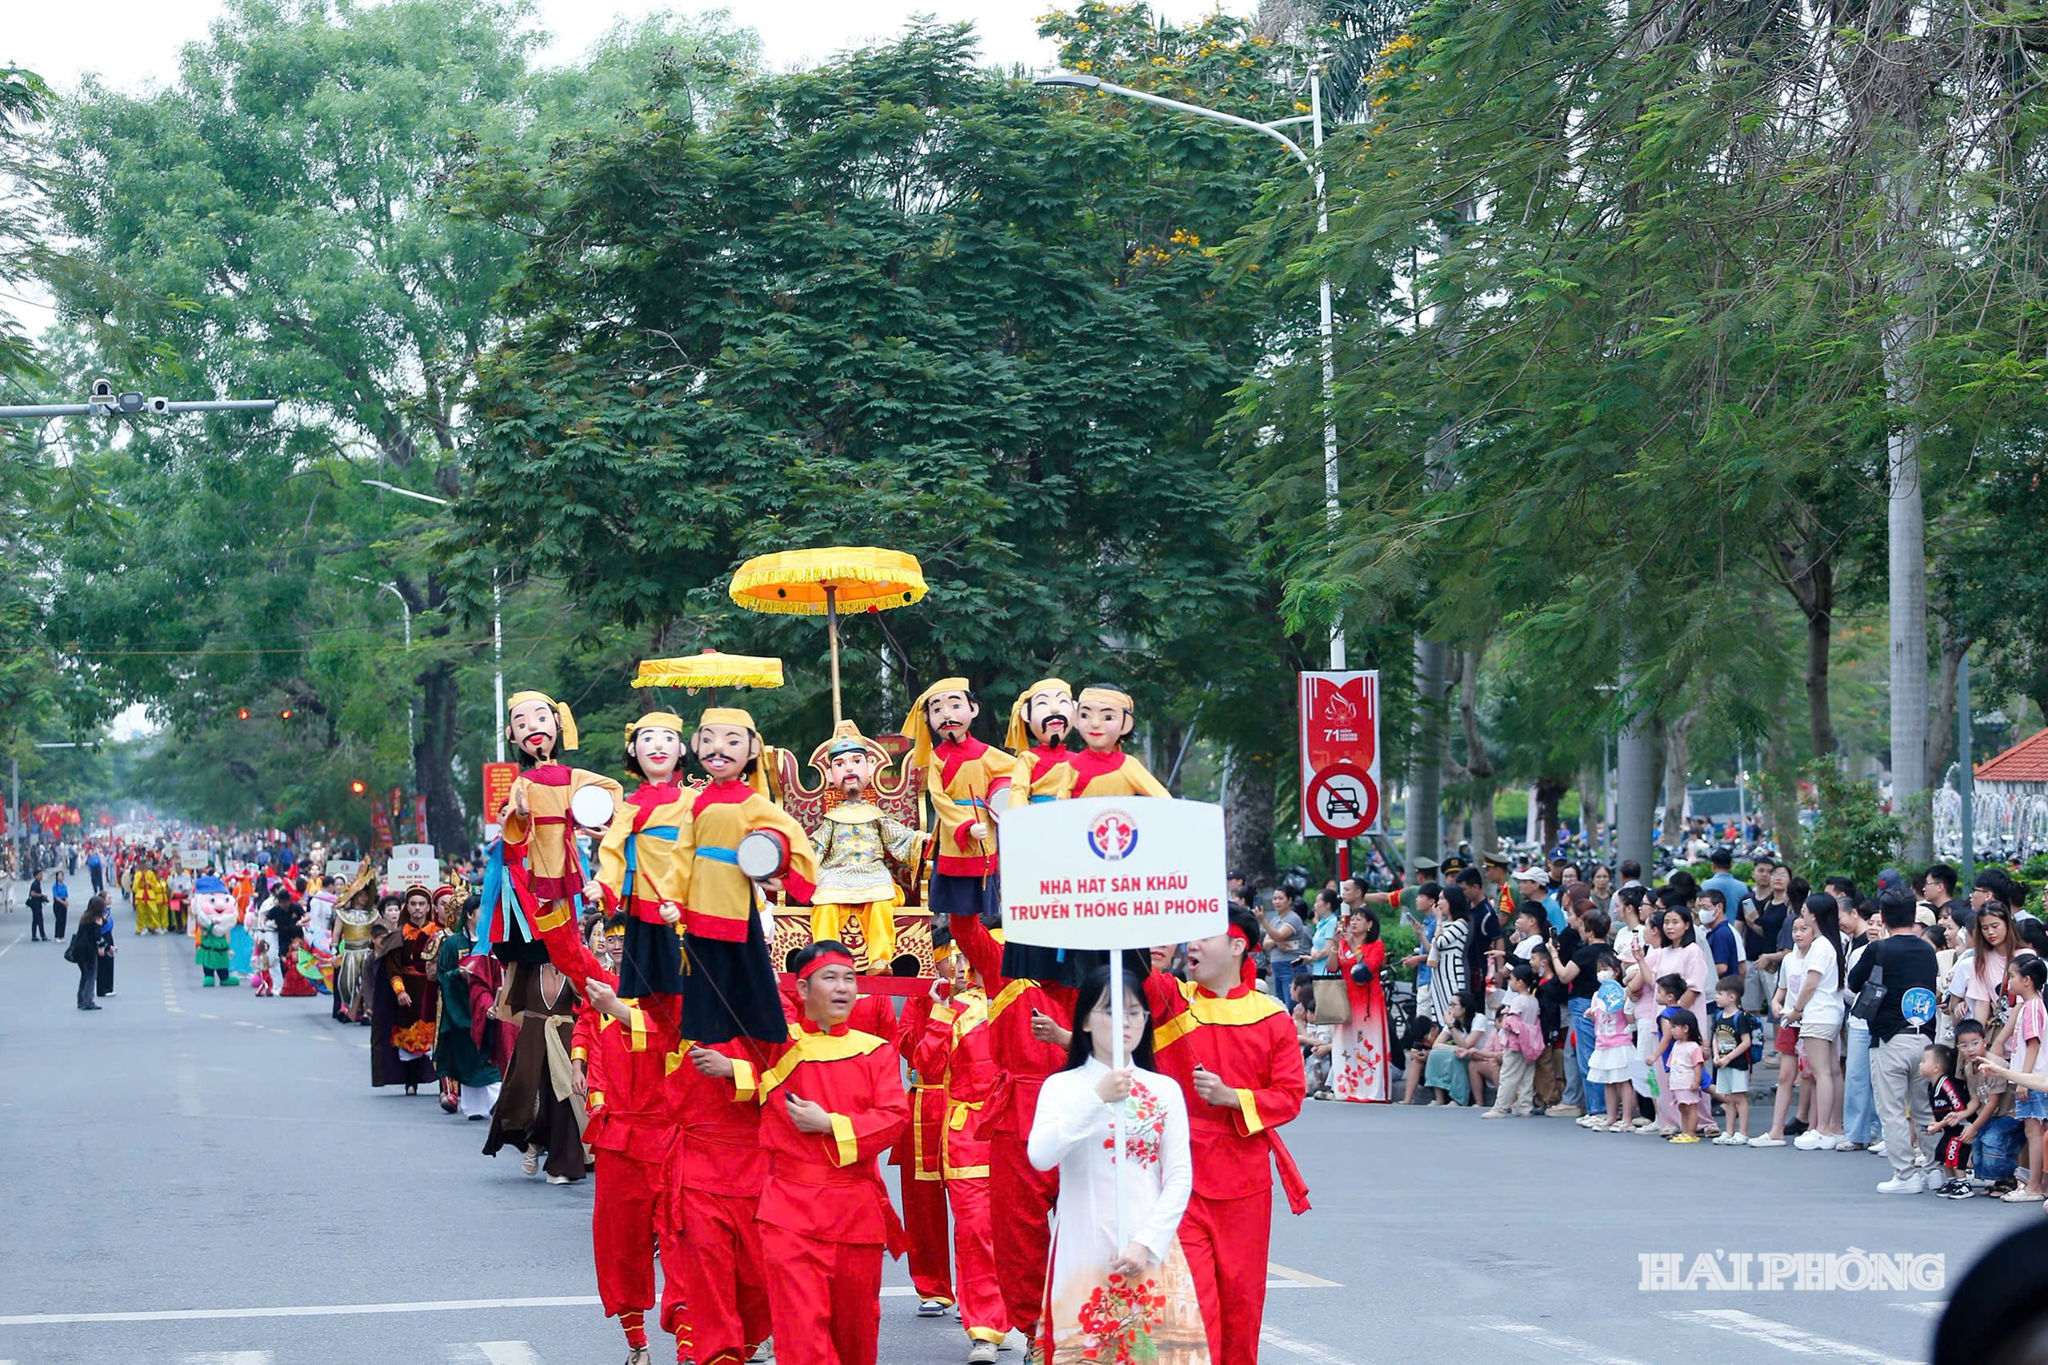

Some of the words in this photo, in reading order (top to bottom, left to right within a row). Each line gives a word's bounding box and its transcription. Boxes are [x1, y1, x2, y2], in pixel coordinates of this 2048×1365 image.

[1324, 729, 1340, 742] 71
[1040, 876, 1072, 895] NHÀ
[1077, 875, 1107, 894] HÁT
[1111, 873, 1141, 892] SÂN
[1146, 870, 1188, 891] KHẤU
[1009, 897, 1070, 920] TRUYỀN
[1074, 896, 1128, 918] THỐNG
[1133, 897, 1159, 916] HẢI
[1165, 895, 1219, 914] PHÒNG
